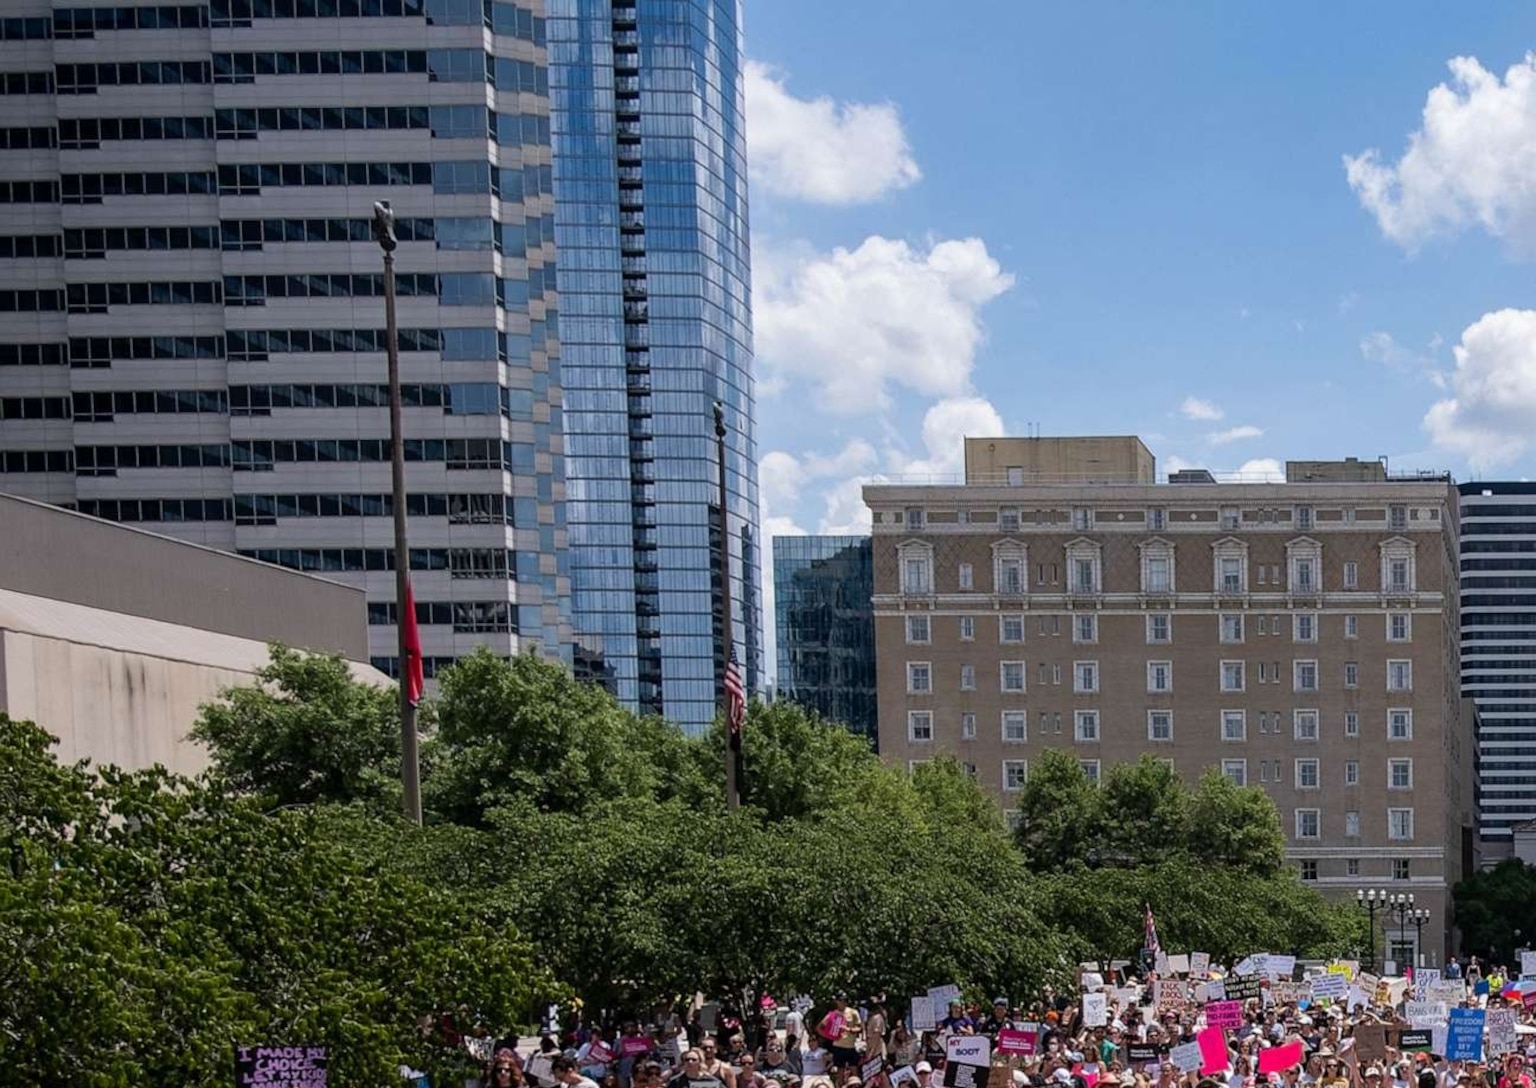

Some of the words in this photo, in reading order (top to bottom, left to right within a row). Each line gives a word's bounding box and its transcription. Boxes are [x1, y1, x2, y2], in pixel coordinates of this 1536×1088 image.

[257, 1047, 304, 1058] MADE
[955, 1048, 980, 1056] BODY
[256, 1058, 317, 1071] CHOICE
[243, 1070, 276, 1083] LET
